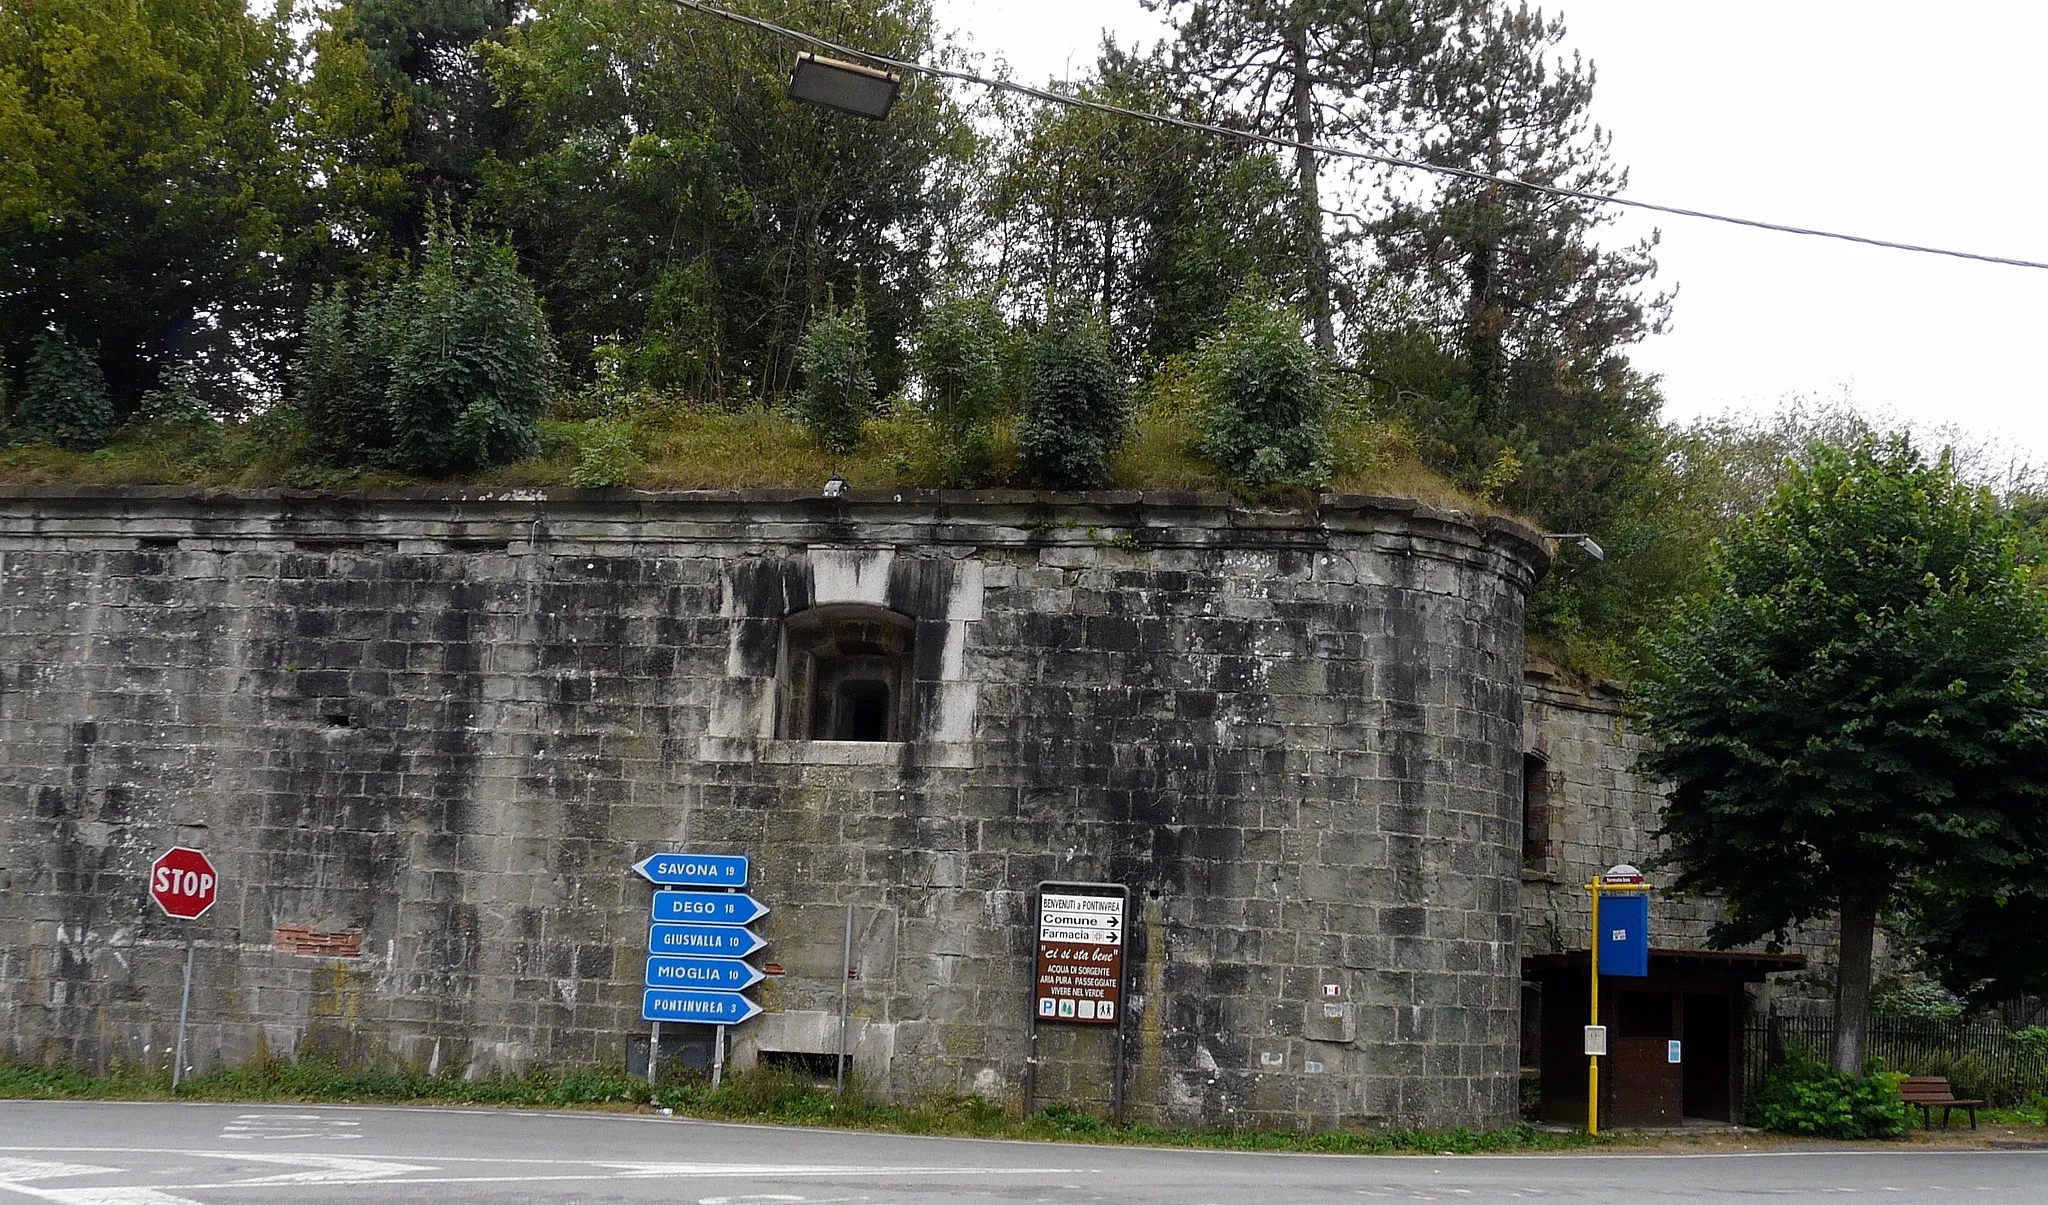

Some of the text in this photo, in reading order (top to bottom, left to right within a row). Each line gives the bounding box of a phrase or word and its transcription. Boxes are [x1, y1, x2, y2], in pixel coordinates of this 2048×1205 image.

[658, 862, 735, 876] SAVONA 19
[155, 867, 213, 898] STOP
[673, 901, 734, 914] DEGO 18
[1043, 898, 1076, 910] BENVENUTI
[1082, 901, 1120, 912] PONTINVREA
[1043, 914, 1098, 926] Comune
[664, 934, 739, 947] GIUSVALLA 10
[1042, 928, 1089, 940] Farmacia
[1061, 948, 1070, 959] si
[1073, 948, 1089, 960] sta
[658, 966, 739, 980] MIOGLIA 10
[1047, 964, 1110, 977] ACQUA DI SORGENTE
[1040, 975, 1116, 988] ARIA PURA PASSEGGIATE
[1051, 986, 1104, 998] VIVERE NEL VERDE
[654, 999, 736, 1014] PONTINVREA 3
